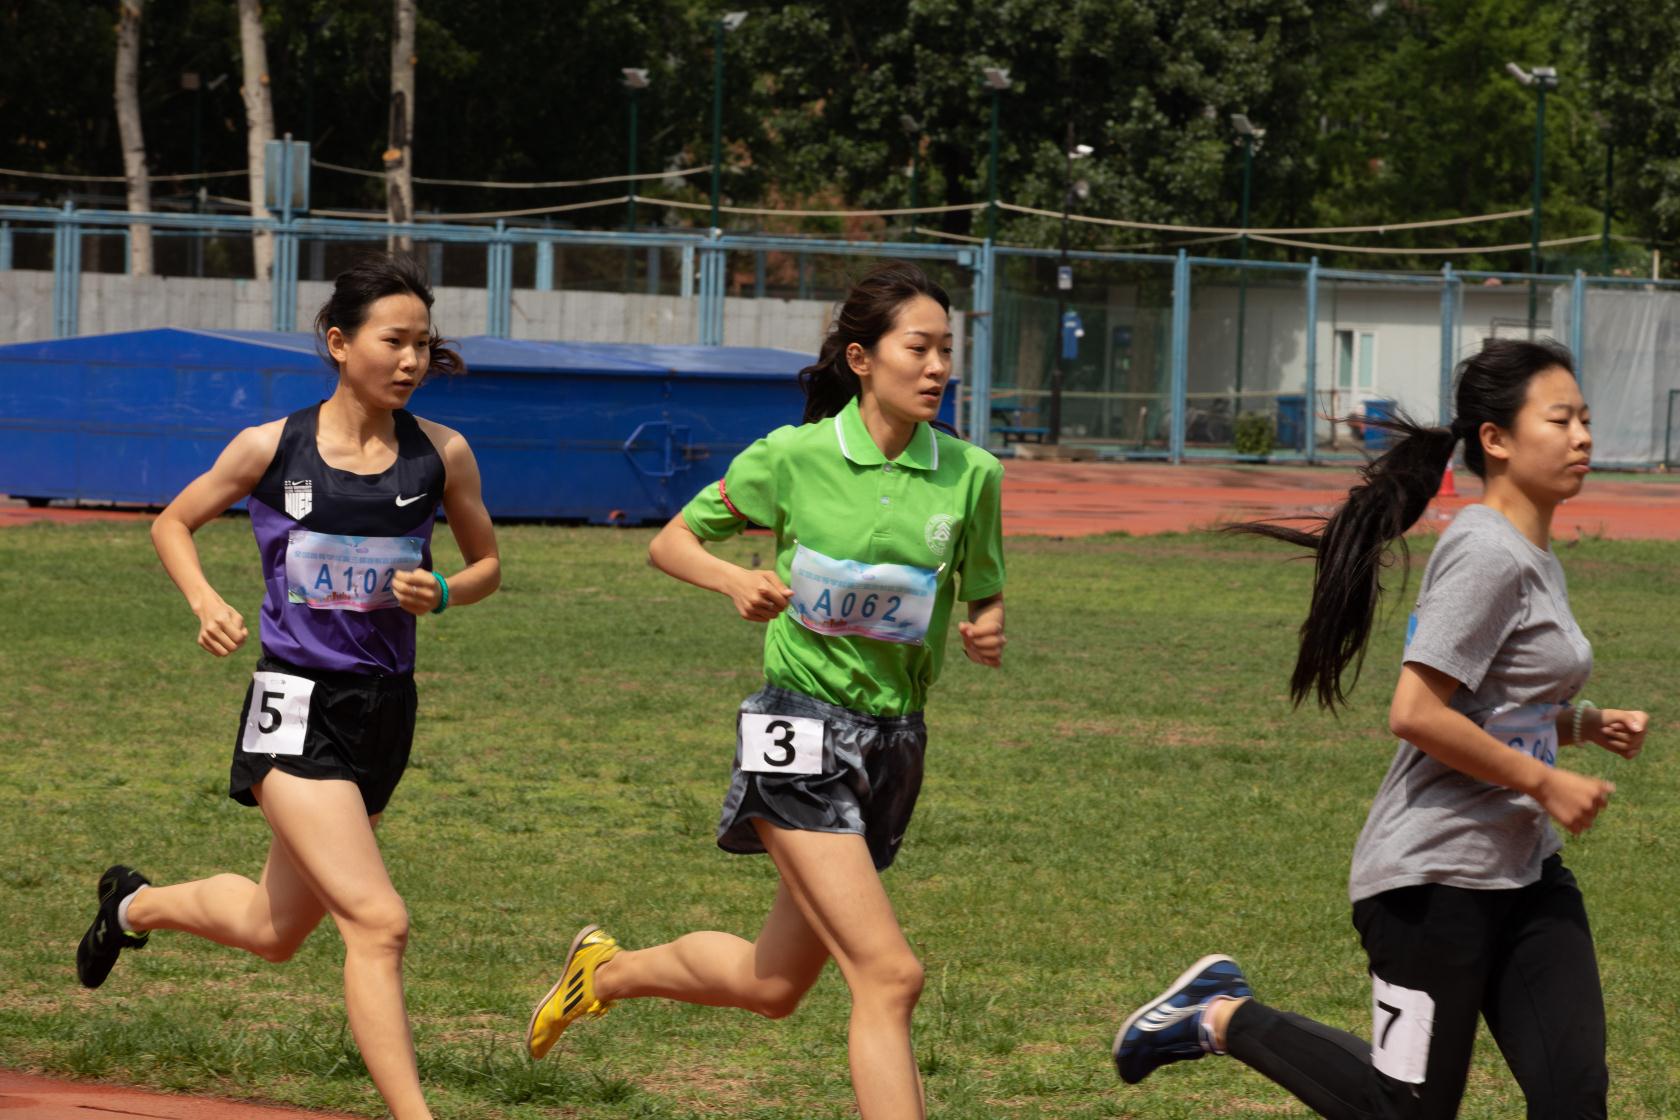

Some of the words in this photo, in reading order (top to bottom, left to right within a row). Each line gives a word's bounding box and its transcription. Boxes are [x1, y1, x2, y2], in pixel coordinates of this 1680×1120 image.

[812, 588, 902, 622] A062
[258, 690, 284, 734] 5
[763, 720, 796, 767] 3
[1376, 999, 1403, 1050] 7
